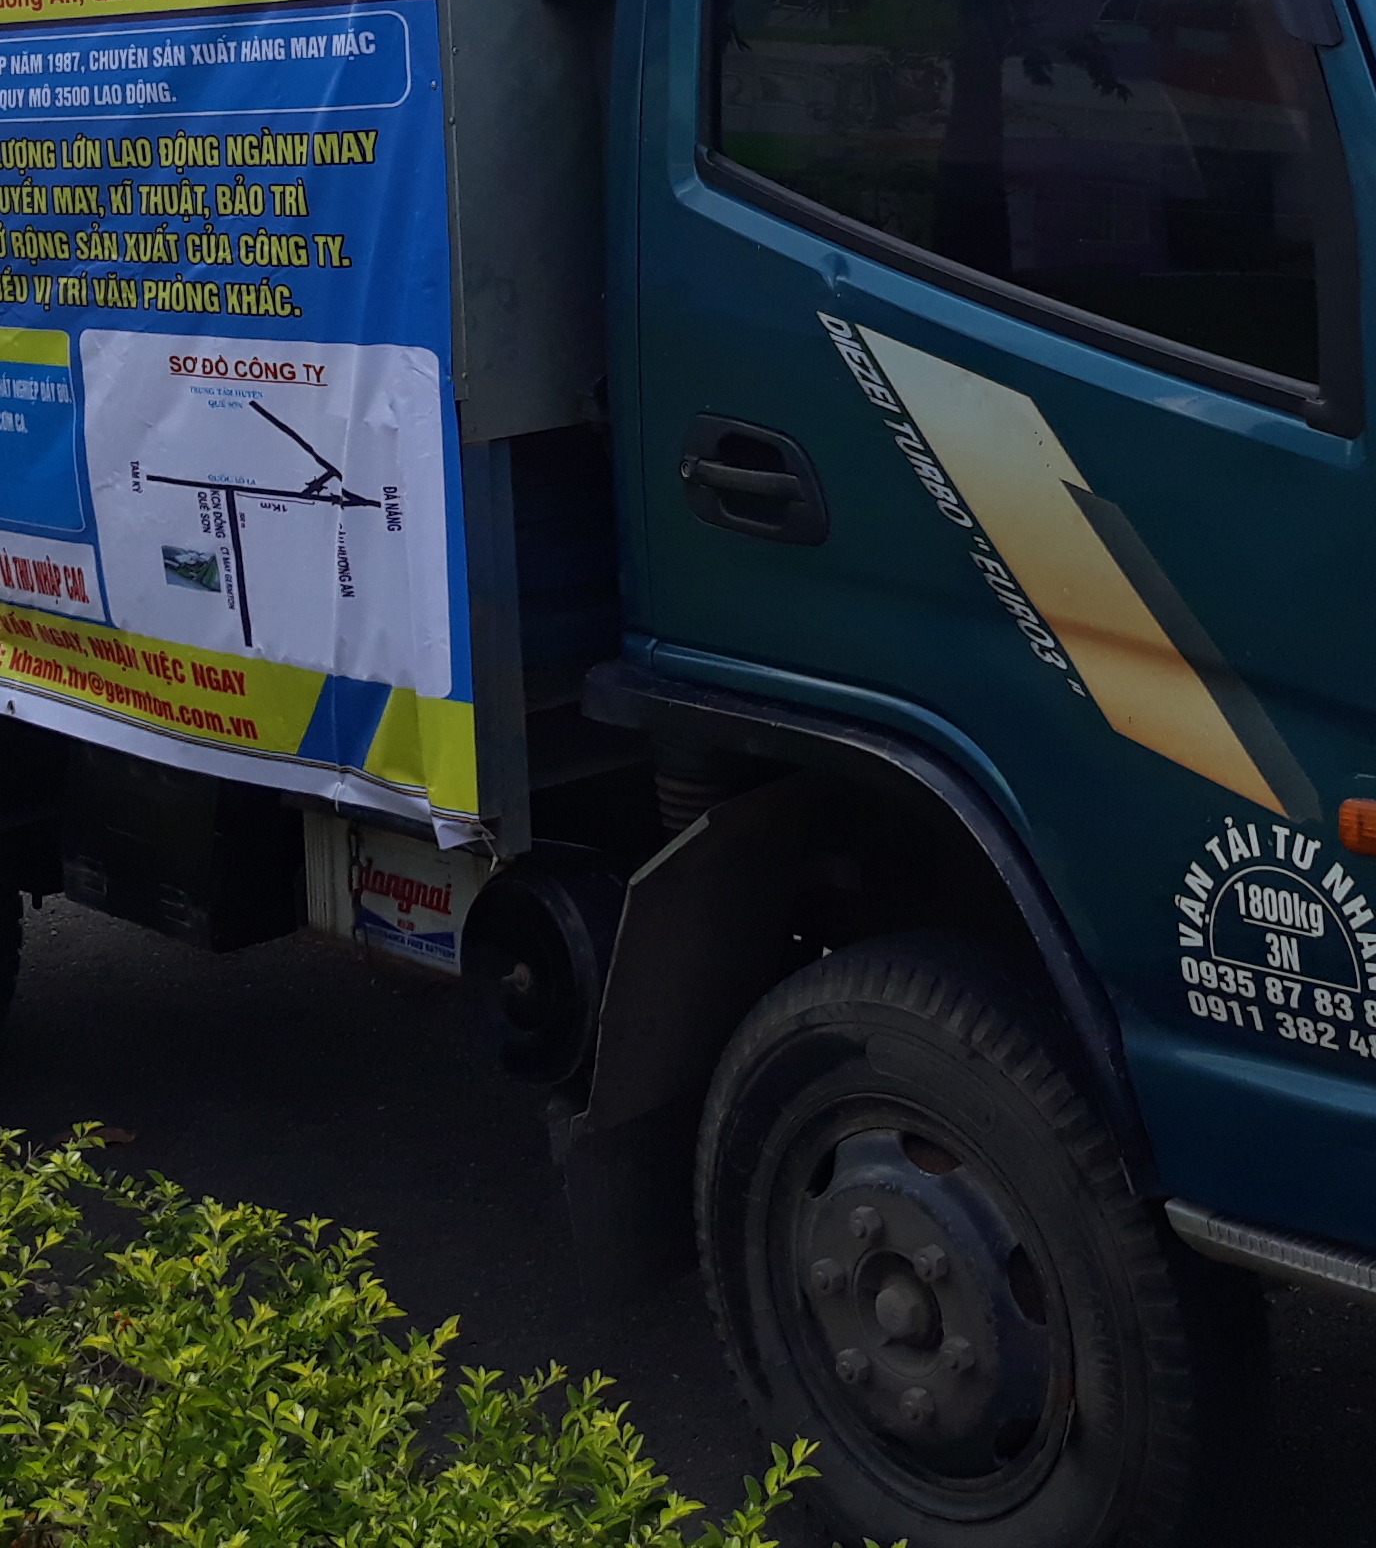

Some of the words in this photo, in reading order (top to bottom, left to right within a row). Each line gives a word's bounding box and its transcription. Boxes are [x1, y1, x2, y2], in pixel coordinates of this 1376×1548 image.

[11, 51, 42, 74] NĂM
[47, 52, 85, 73] 1987,
[89, 44, 148, 71] CHUYÊN
[152, 38, 186, 68] SẢN
[191, 35, 236, 66] XUẤT
[240, 35, 285, 62] HÀNG
[291, 35, 328, 59] MAY
[332, 28, 376, 60] MẶC
[62, 132, 102, 169] LỚN
[106, 137, 152, 168] LAO
[158, 129, 220, 174] ĐỘNG
[226, 126, 309, 167] NGÀNH
[313, 130, 378, 166] MAY
[92, 272, 138, 308] VĂN
[142, 274, 220, 313] PHÒNG
[226, 277, 302, 318] KHÁC.
[169, 355, 198, 373] SƠ
[202, 354, 228, 376] ĐỒ
[234, 357, 296, 380] CÔNG
[303, 363, 326, 383] TY
[383, 486, 398, 502] ĐÀ
[883, 419, 973, 529] TURBO
[210, 490, 221, 509] KCN
[36, 623, 88, 657] NGAY,
[88, 636, 140, 672] NHẬN
[142, 648, 186, 686] VIỆC
[191, 661, 246, 696] NGAY
[1174, 861, 1214, 948] VẬN
[1205, 816, 1261, 870] TẢI
[1272, 824, 1321, 870] TƯ
[1234, 882, 1324, 937] 1800kg
[1265, 932, 1300, 972] 3N
[1181, 956, 1255, 998] 0935
[1265, 977, 1301, 1008] 87
[1314, 989, 1354, 1022] 83
[1187, 991, 1263, 1032] 0911
[1276, 1012, 1339, 1051] 382
